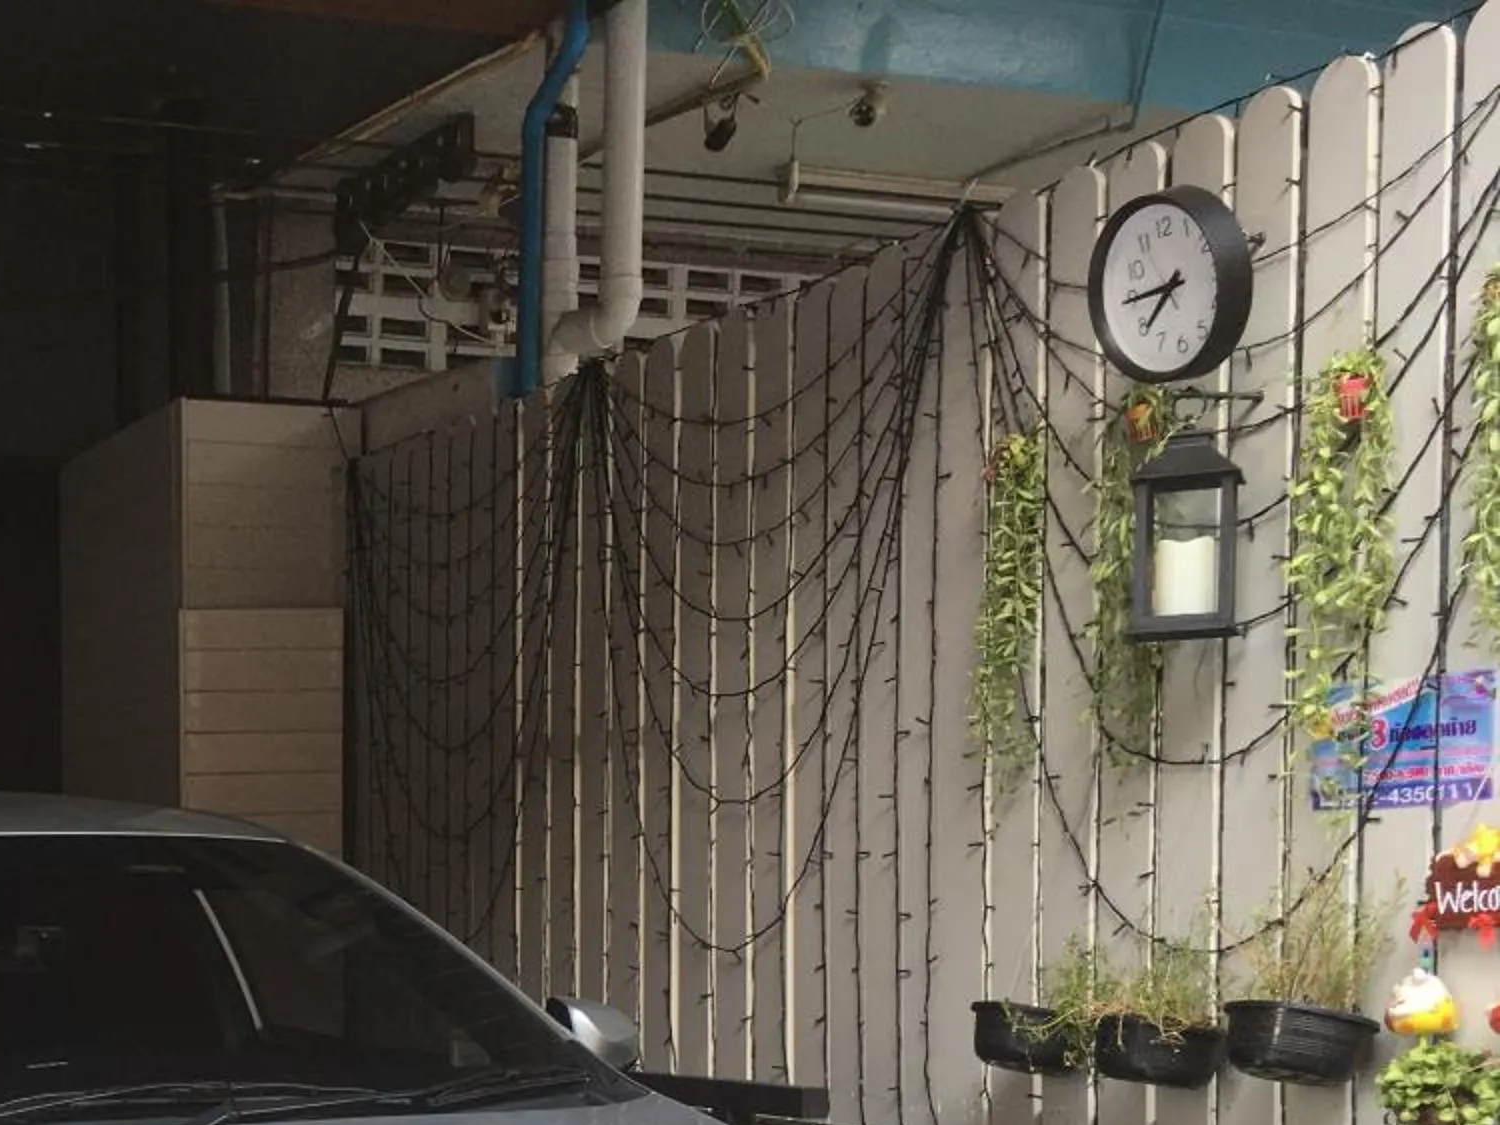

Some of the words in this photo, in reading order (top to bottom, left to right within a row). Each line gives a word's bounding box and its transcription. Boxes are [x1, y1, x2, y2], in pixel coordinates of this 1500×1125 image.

[1155, 215, 1173, 239] 12
[1137, 231, 1151, 253] 11
[1128, 259, 1146, 282] 10
[1155, 331, 1166, 353] 7
[1176, 334, 1190, 354] 6
